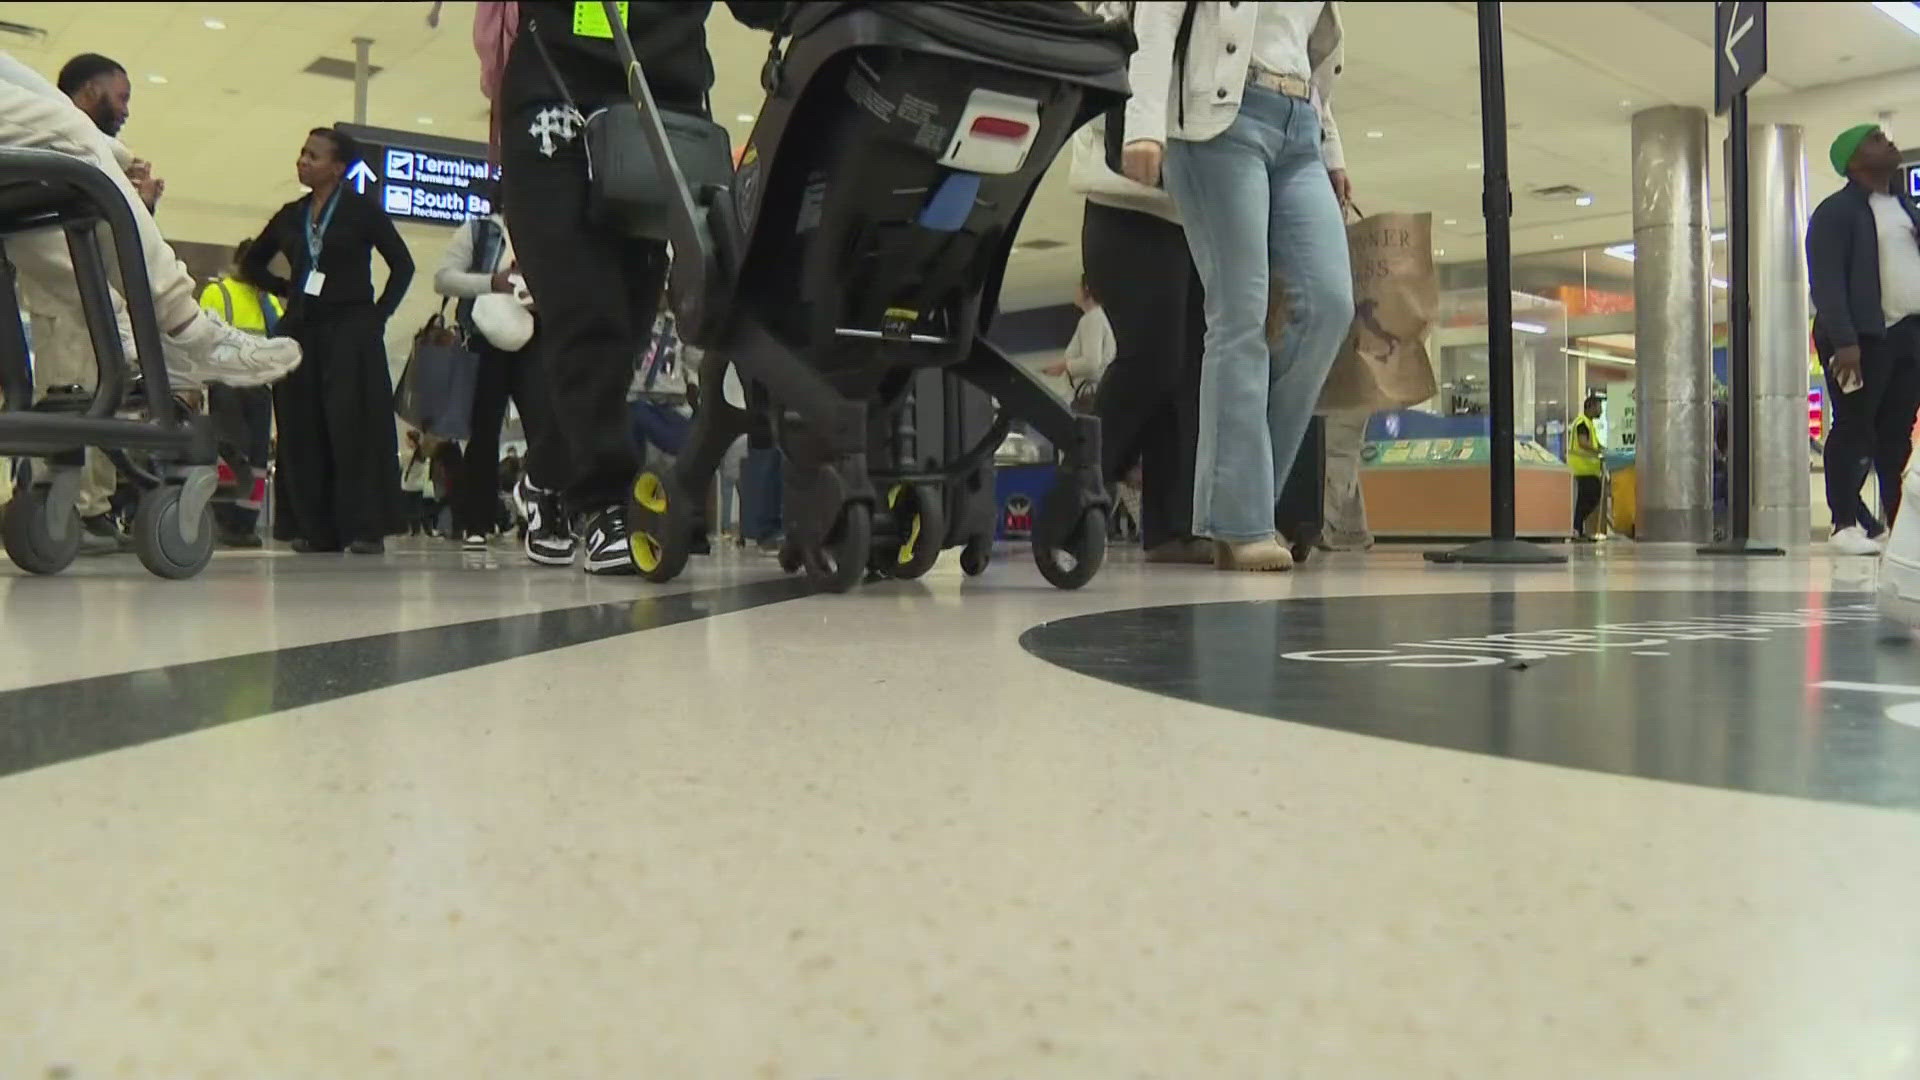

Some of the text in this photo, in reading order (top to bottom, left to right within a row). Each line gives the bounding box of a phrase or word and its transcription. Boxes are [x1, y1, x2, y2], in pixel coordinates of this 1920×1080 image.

[415, 153, 489, 180] Terminal
[415, 172, 470, 188] Terminal Sur
[413, 188, 491, 214] South Ba
[413, 206, 451, 220] Reclamo
[452, 211, 465, 221] de
